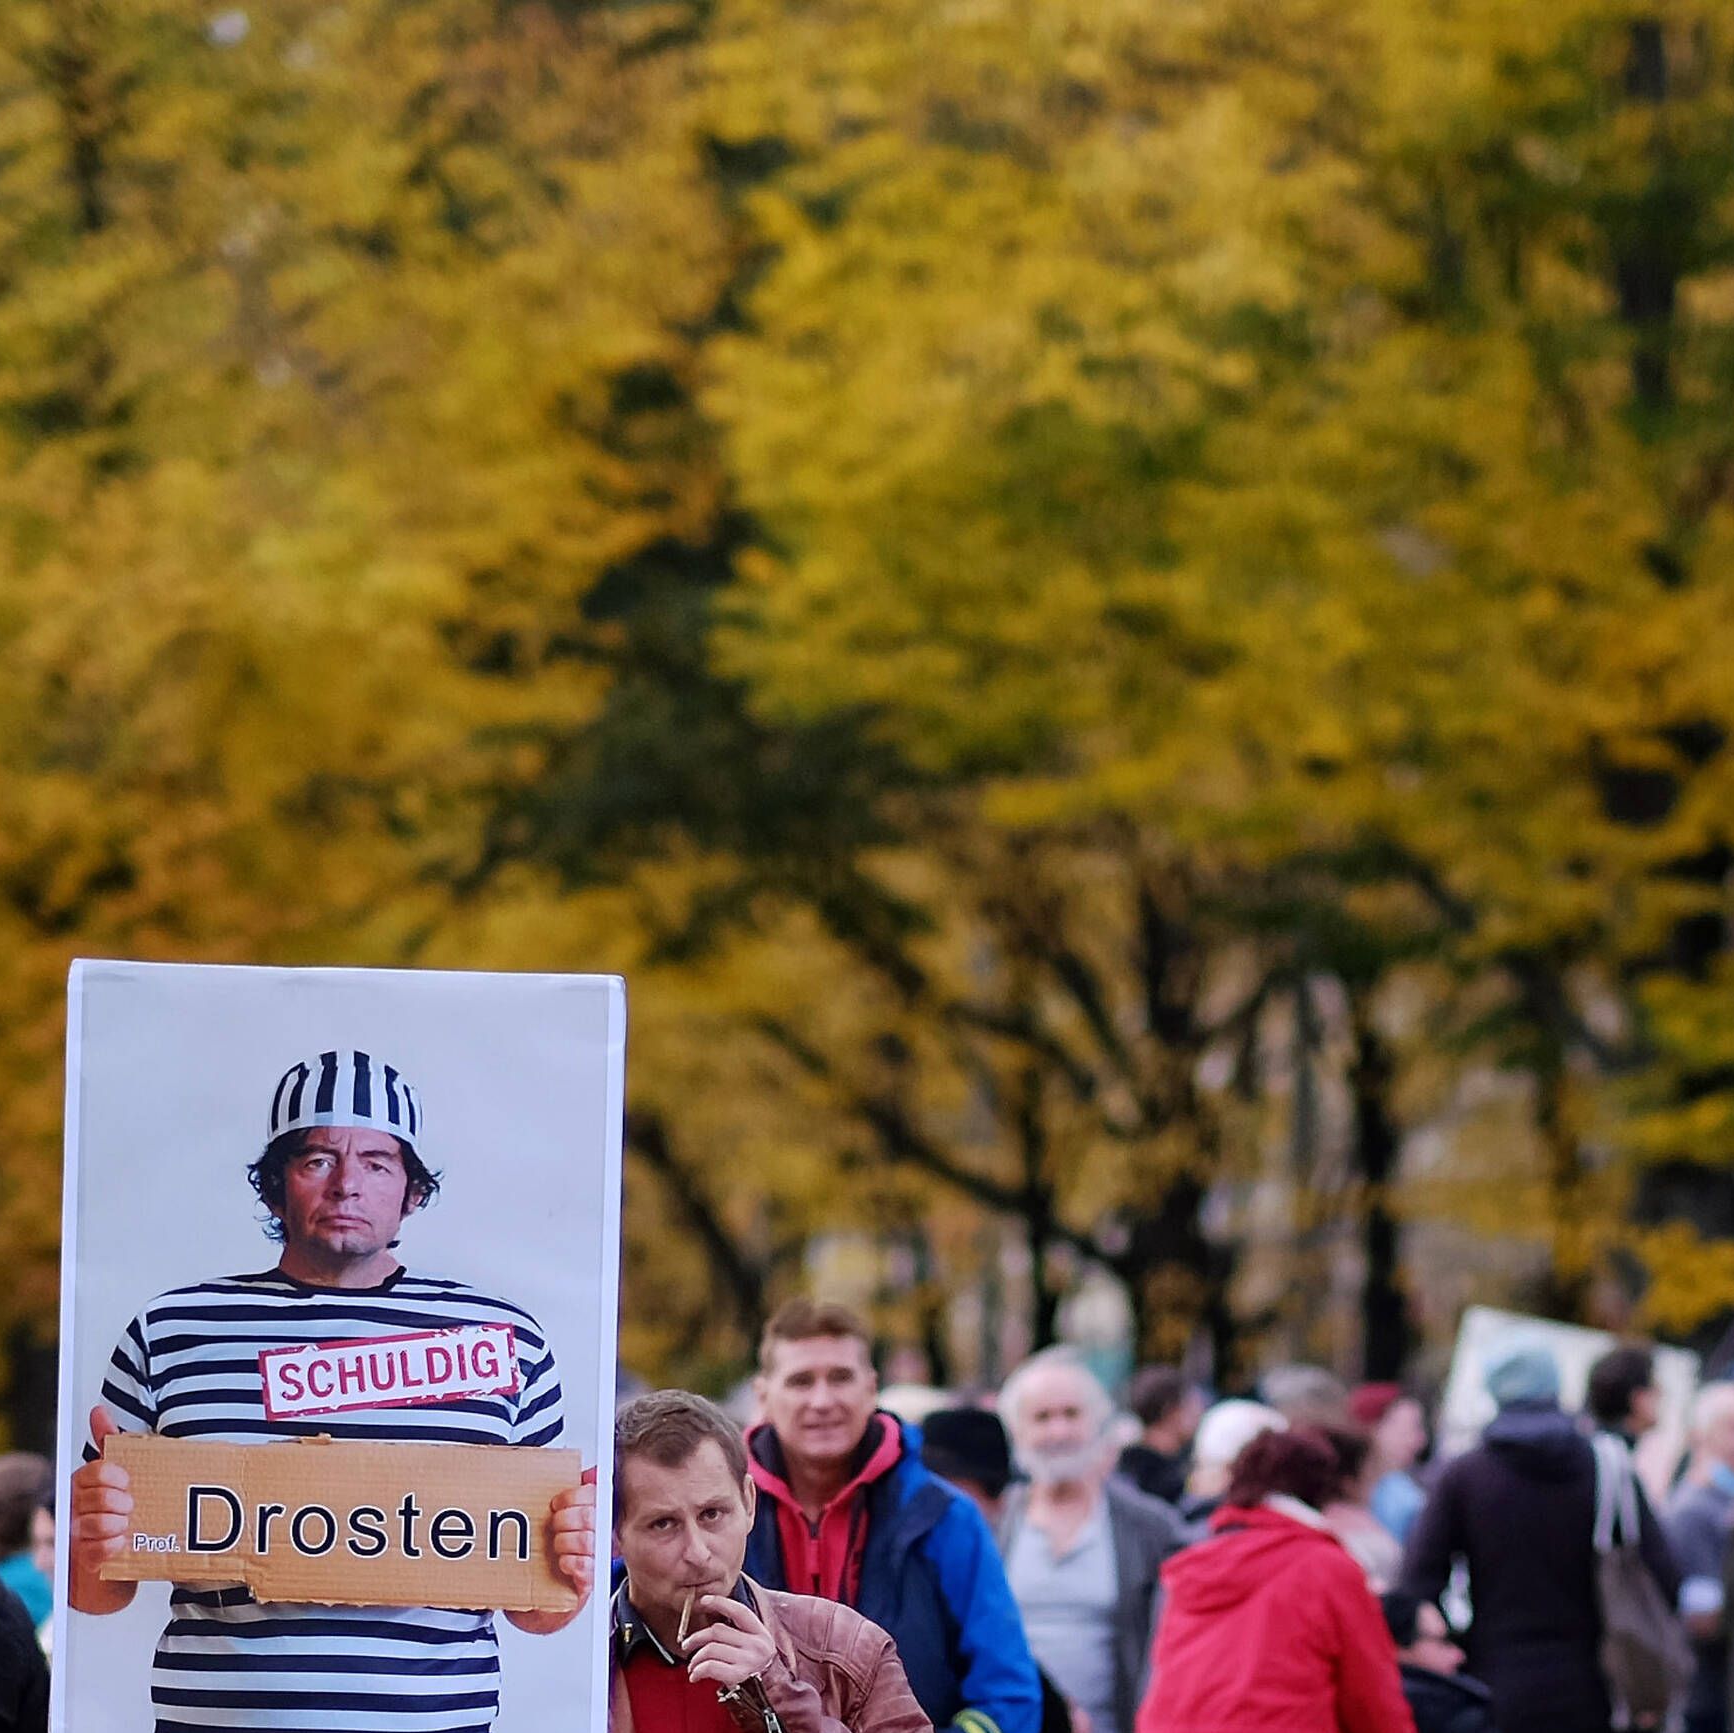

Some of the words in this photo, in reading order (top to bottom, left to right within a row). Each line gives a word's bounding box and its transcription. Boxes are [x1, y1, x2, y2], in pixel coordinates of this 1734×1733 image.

[278, 1340, 500, 1401] SCHULDIG
[134, 1532, 181, 1553] Prof.
[186, 1484, 530, 1560] Drosten
